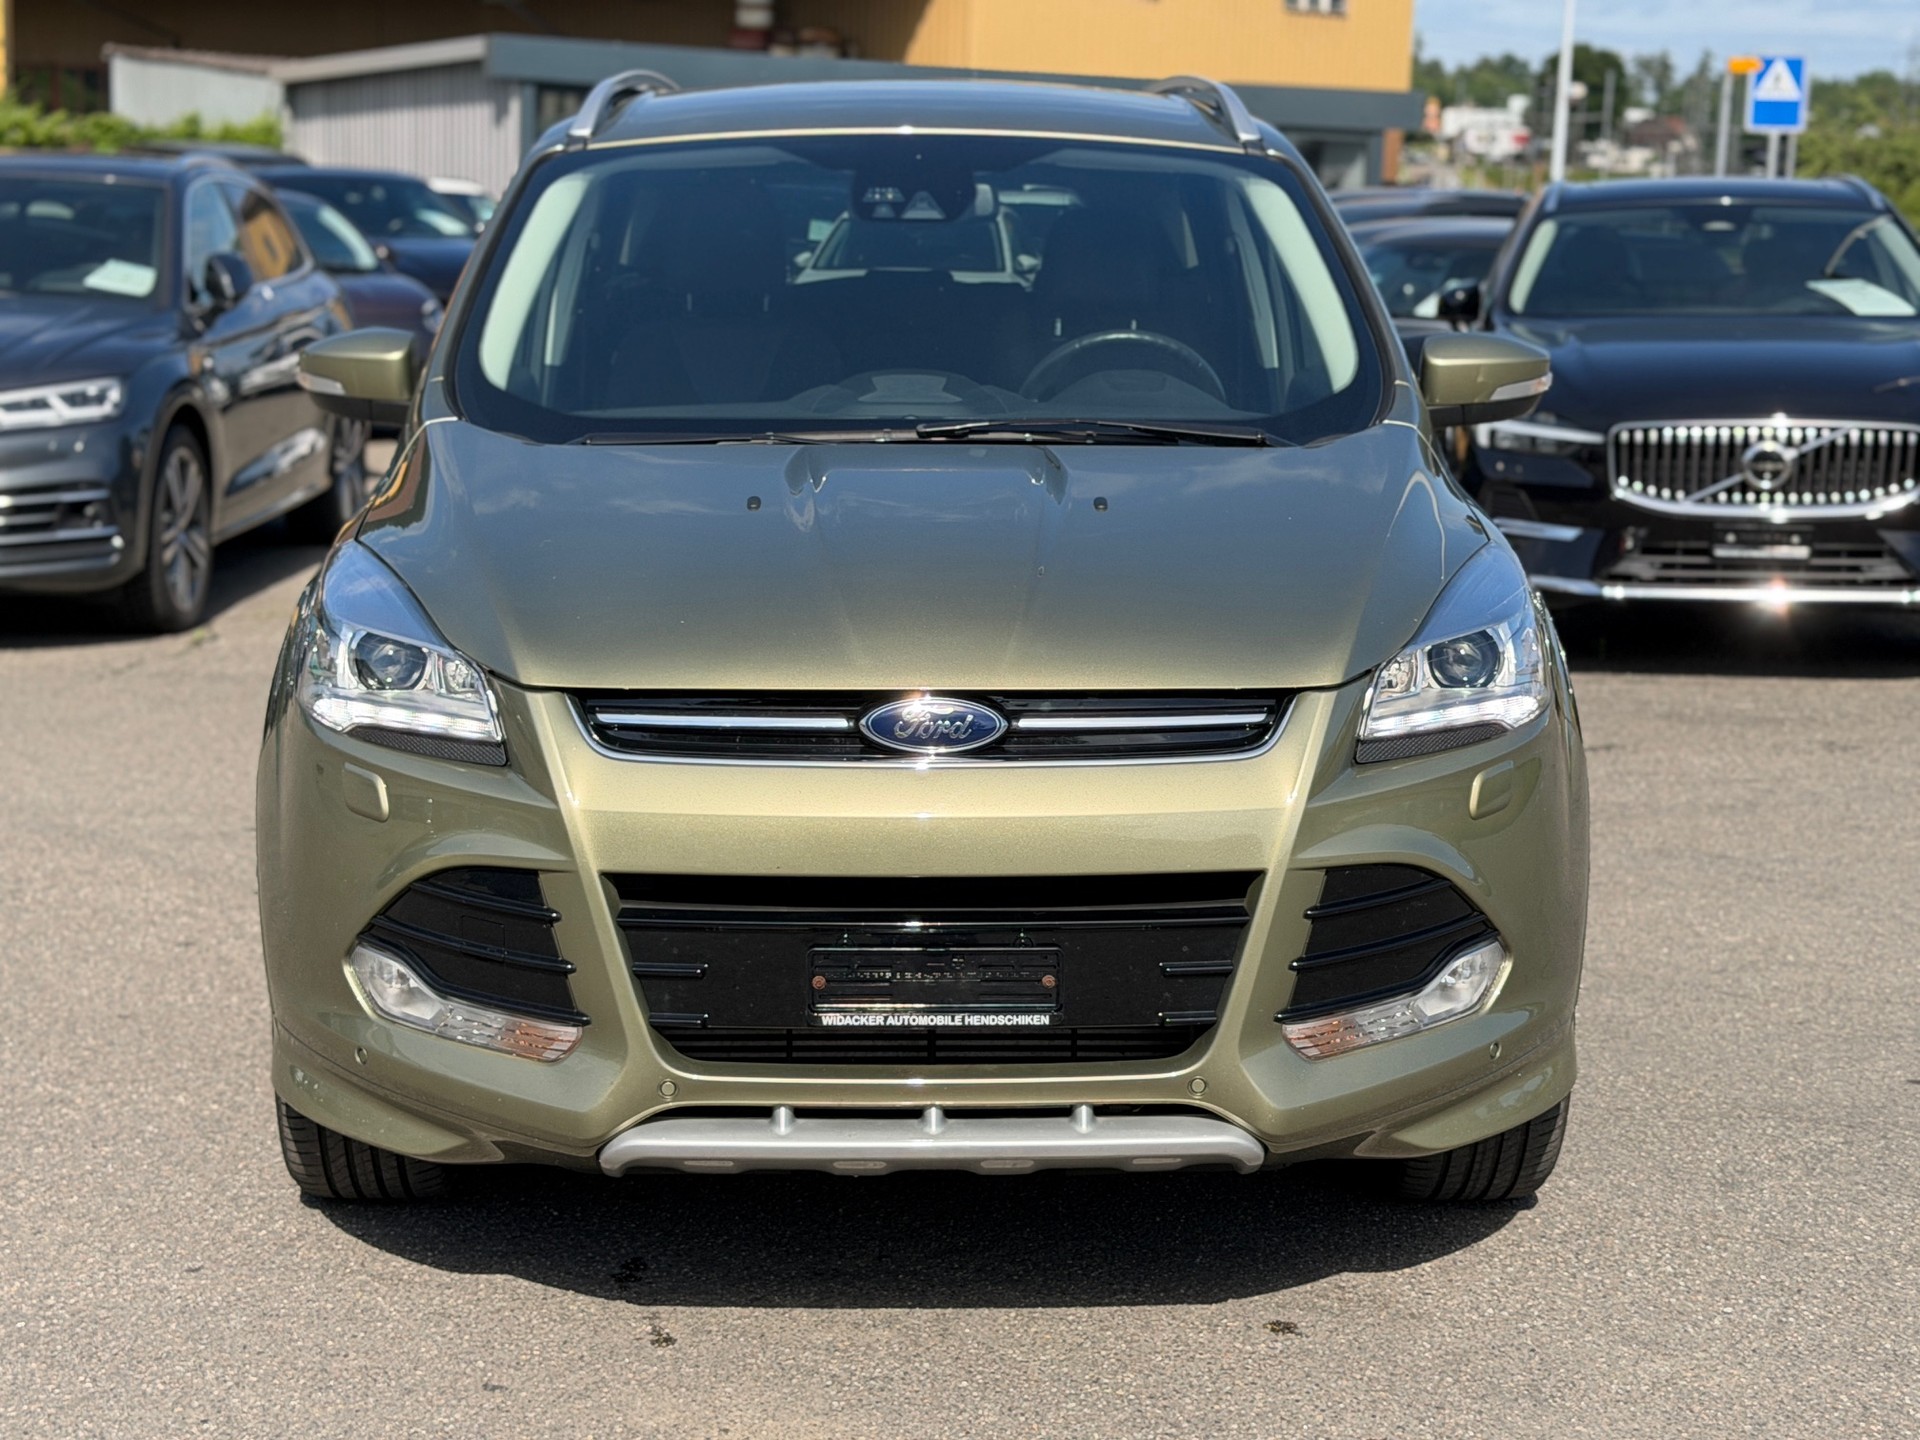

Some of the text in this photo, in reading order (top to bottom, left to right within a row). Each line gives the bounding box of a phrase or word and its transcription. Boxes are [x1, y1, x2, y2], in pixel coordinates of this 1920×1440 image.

[893, 703, 974, 739] Ford
[821, 1013, 1050, 1026] WIDACKER AUTOMOBILE HENDSCHIKEN
